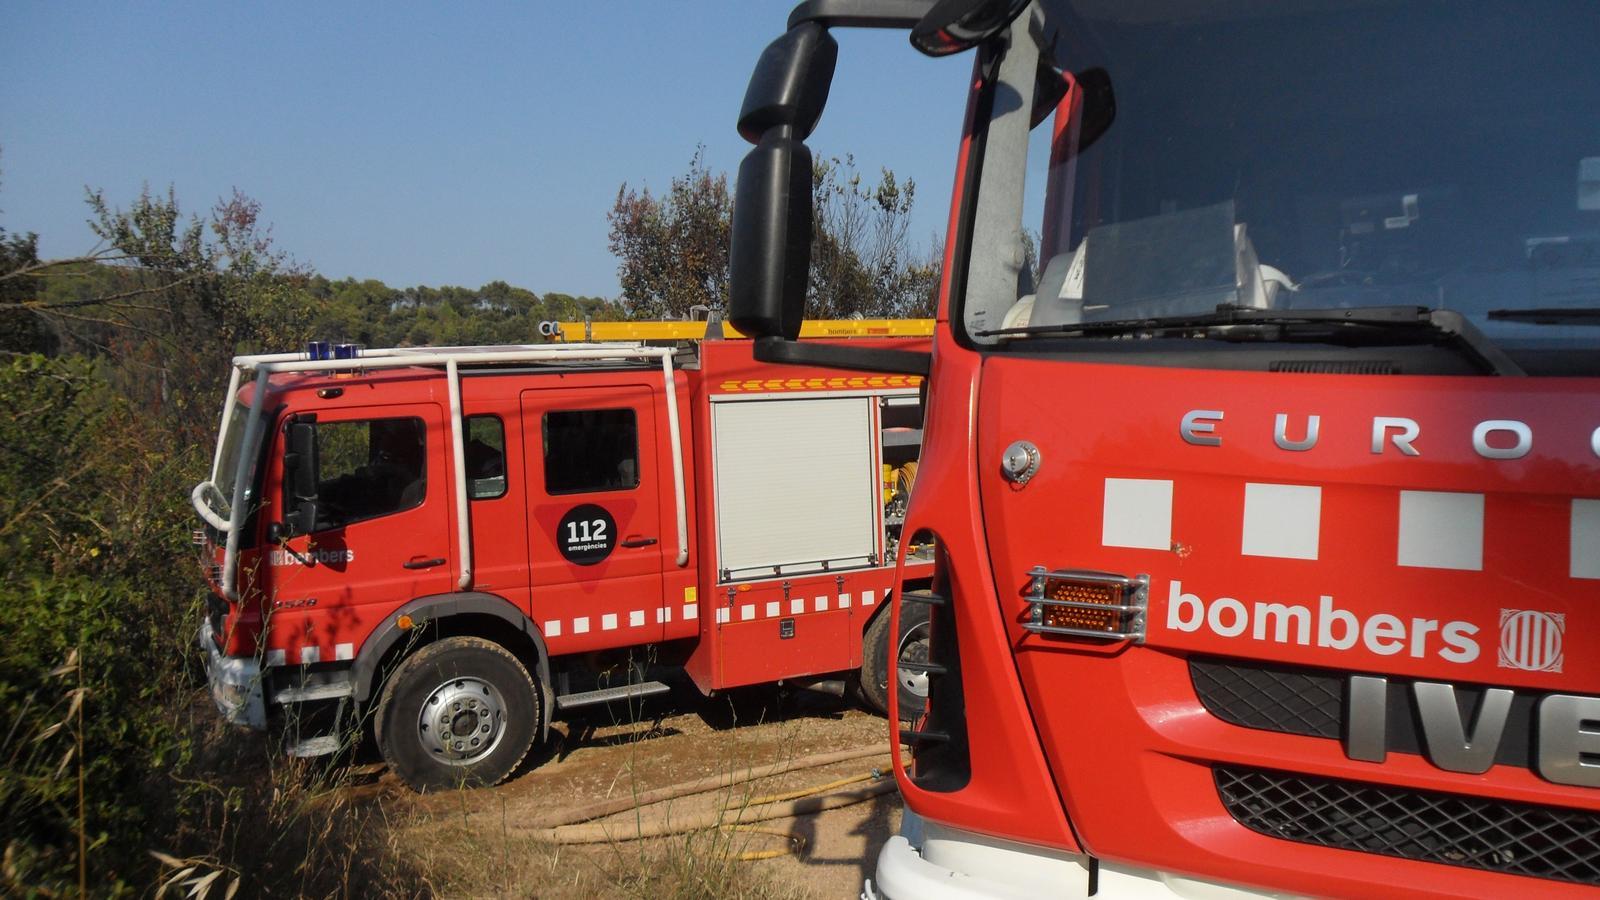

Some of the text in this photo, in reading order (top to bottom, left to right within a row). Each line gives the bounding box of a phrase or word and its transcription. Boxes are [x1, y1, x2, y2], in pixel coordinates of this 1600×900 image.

[1180, 410, 1600, 460] EURO
[567, 519, 607, 543] 112
[568, 542, 607, 551] emergències
[1166, 580, 1481, 664] bombers
